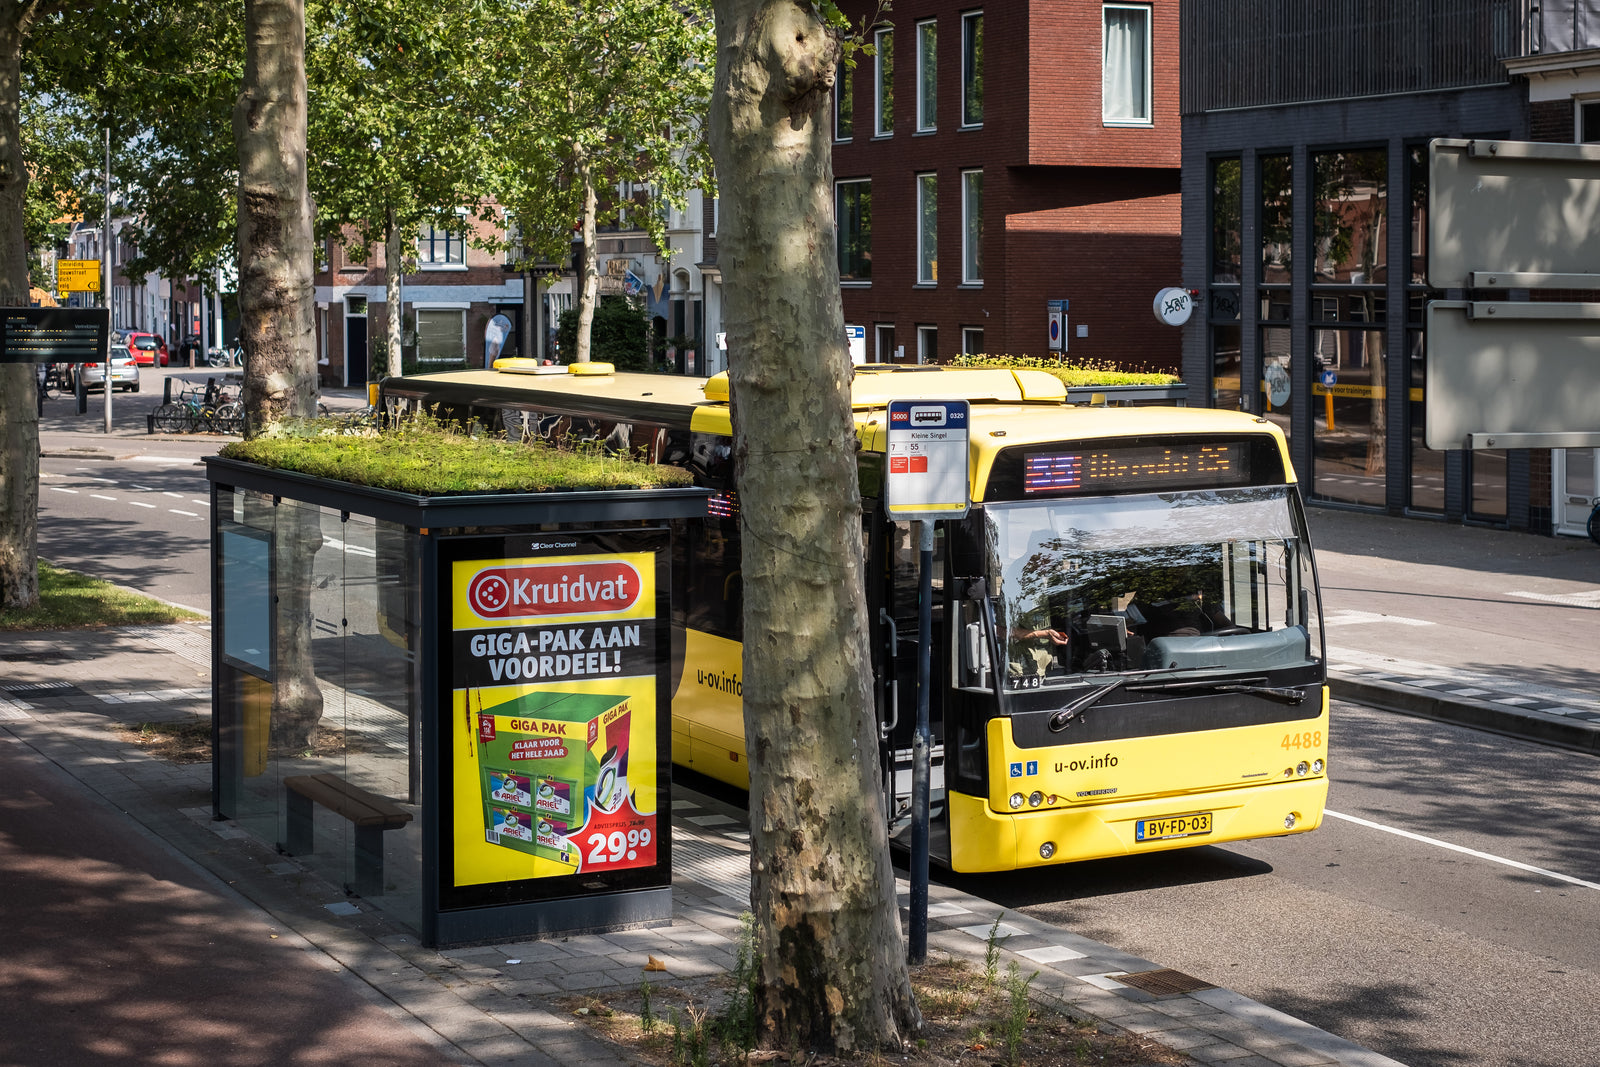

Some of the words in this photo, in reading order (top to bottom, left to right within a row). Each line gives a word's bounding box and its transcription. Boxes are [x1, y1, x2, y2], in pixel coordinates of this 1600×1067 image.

[513, 574, 628, 605] Kruidvat
[470, 628, 586, 657] GIGA-PAK
[590, 625, 640, 649] AAN
[488, 650, 622, 681] VOORDEEL!
[697, 669, 743, 697] u-ov.info
[602, 710, 618, 725] GIGA
[618, 702, 628, 716] PAK
[510, 719, 542, 733] GIGA
[544, 722, 566, 735] PAK
[514, 740, 538, 749] KLAAR
[540, 739, 560, 747] VOOR
[1280, 731, 1322, 751] 4488
[511, 751, 524, 759] HET
[526, 750, 542, 758] HELE
[544, 748, 564, 757] JAAR
[1054, 754, 1118, 773] u-ov.info
[501, 792, 522, 803] ARIEL
[536, 799, 559, 810] ARIEL
[502, 827, 523, 837] ARIEL
[1149, 816, 1208, 836] BV-FD-03
[537, 835, 557, 846] ARIEL
